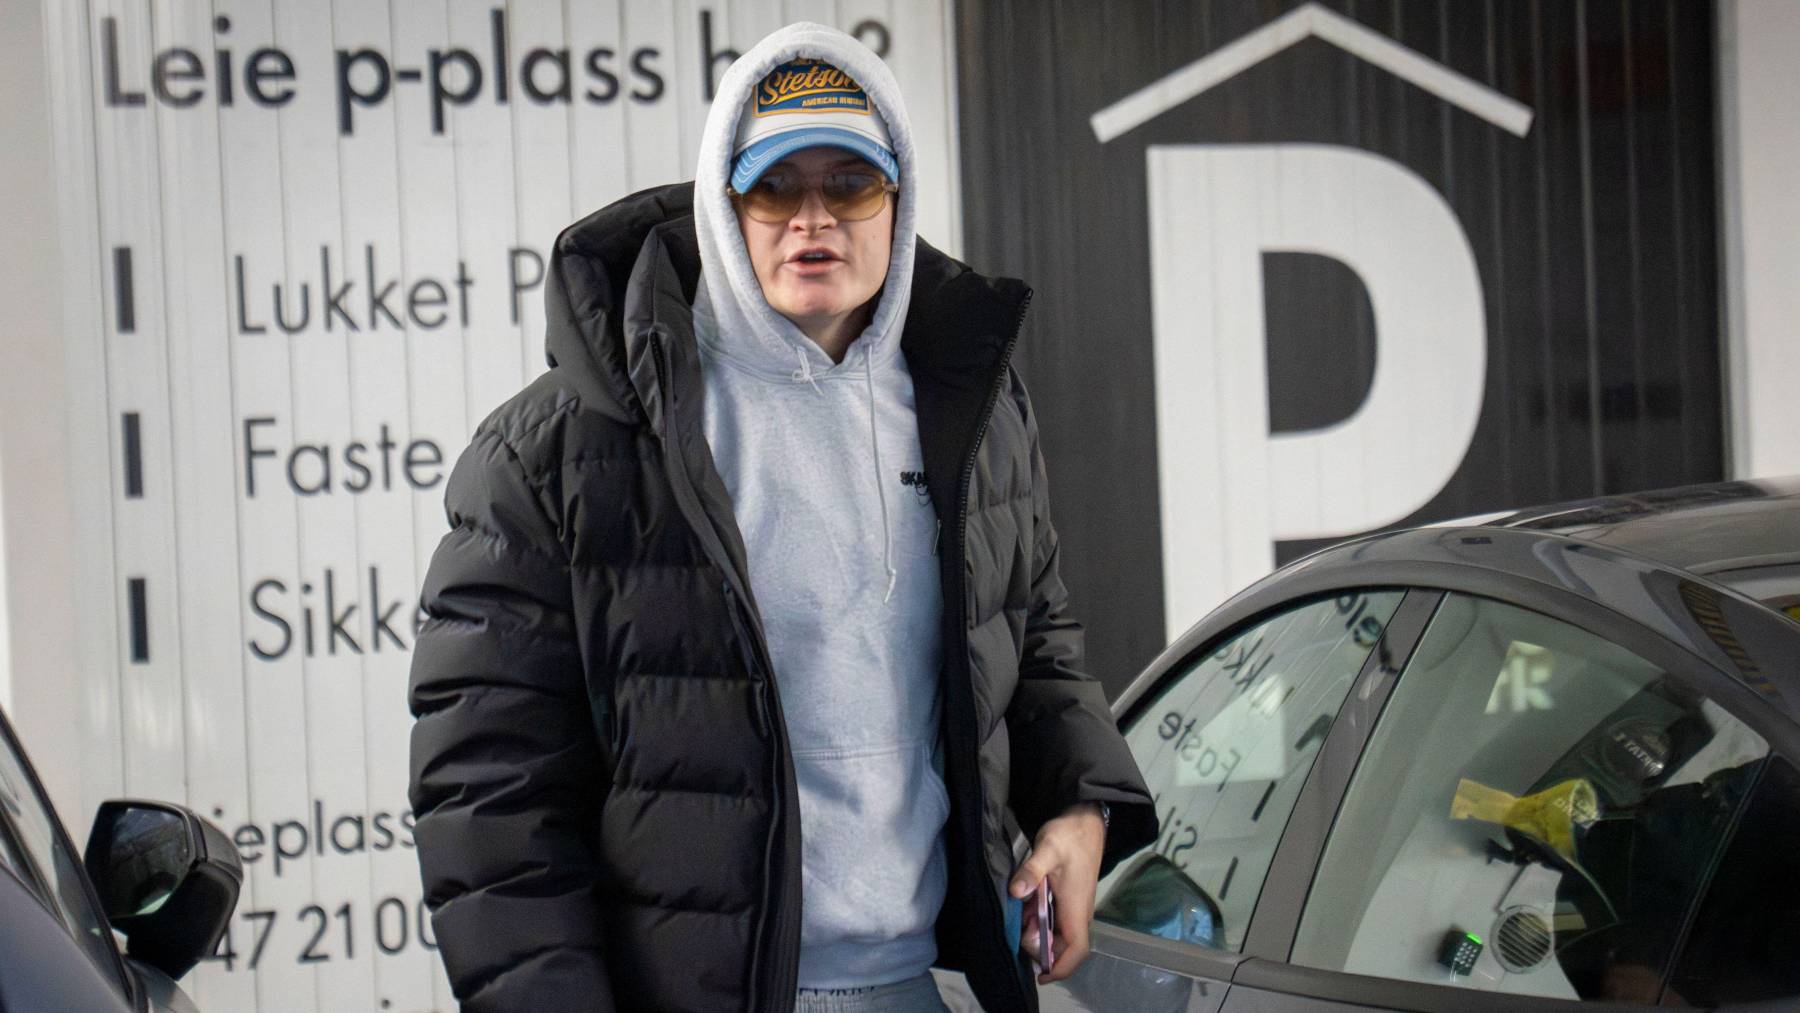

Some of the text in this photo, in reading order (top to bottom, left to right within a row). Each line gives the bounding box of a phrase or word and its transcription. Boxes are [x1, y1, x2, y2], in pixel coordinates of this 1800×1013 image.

[102, 16, 296, 108] Leie
[334, 8, 666, 135] p-plass
[235, 244, 474, 335] Lukket
[1146, 142, 1487, 647] P
[243, 417, 444, 498] Faste
[213, 799, 416, 878] eplass
[298, 902, 354, 963] 21
